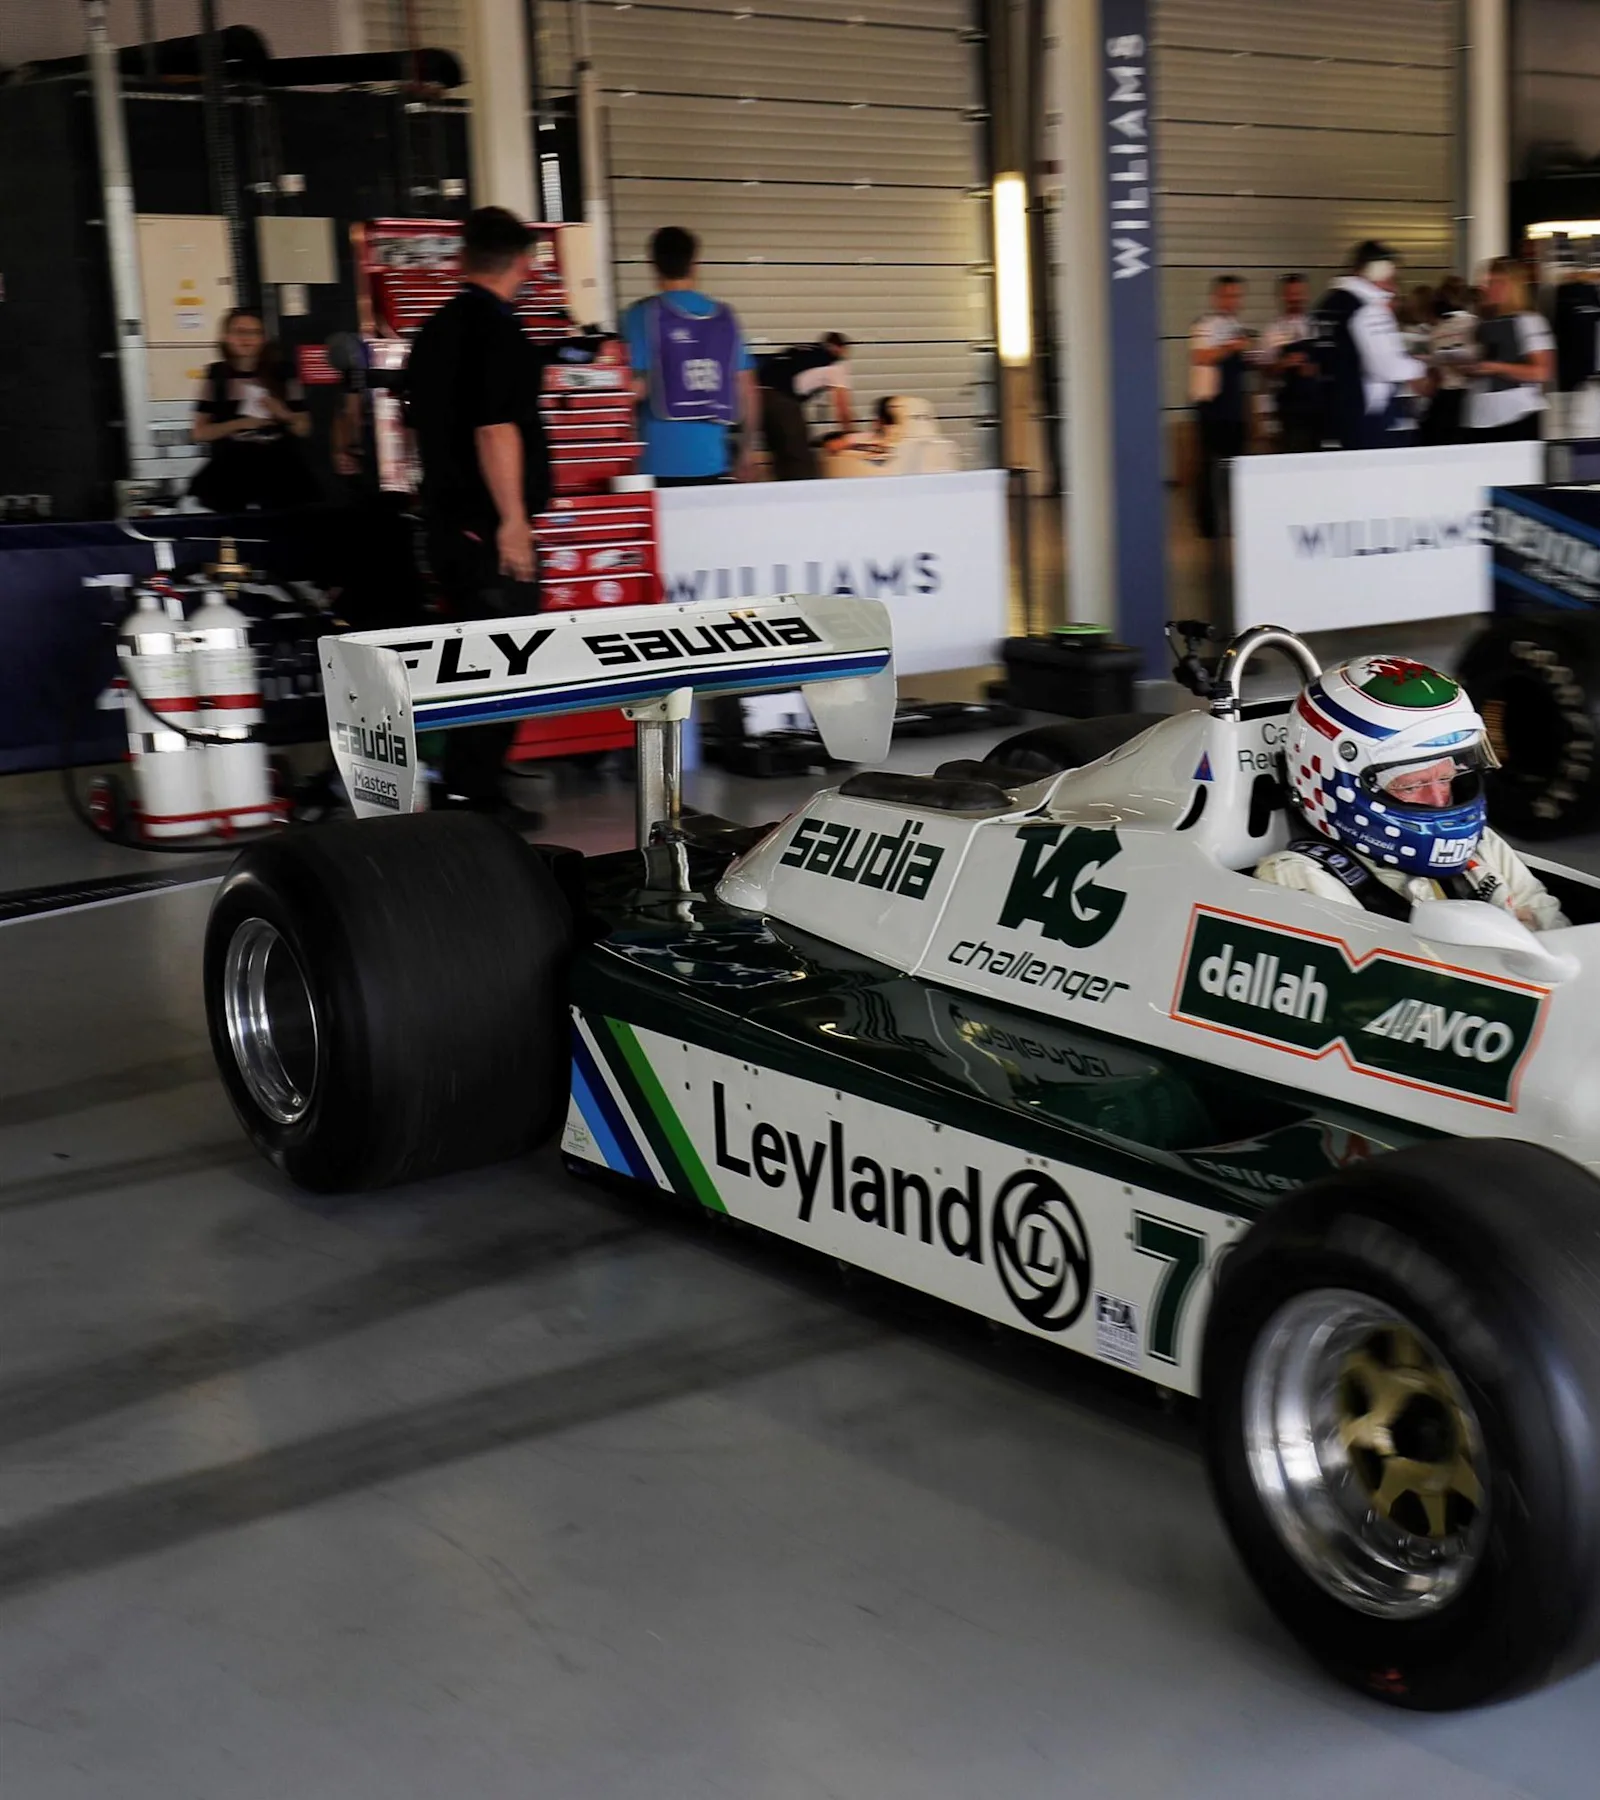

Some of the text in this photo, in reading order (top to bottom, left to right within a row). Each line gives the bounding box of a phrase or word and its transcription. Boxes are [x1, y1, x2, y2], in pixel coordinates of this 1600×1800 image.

[1105, 34, 1150, 280] WILLIAMS
[1288, 510, 1494, 558] WILLIAMS
[663, 552, 944, 602] WILLIAMS
[582, 610, 823, 666] saudia
[336, 721, 408, 768] saudia
[354, 766, 399, 798] Masters
[779, 817, 945, 901] saudia
[997, 823, 1128, 949] TAG
[948, 940, 1131, 1003] challenger
[1199, 943, 1328, 1024] dallah
[712, 1081, 985, 1265] Leyland
